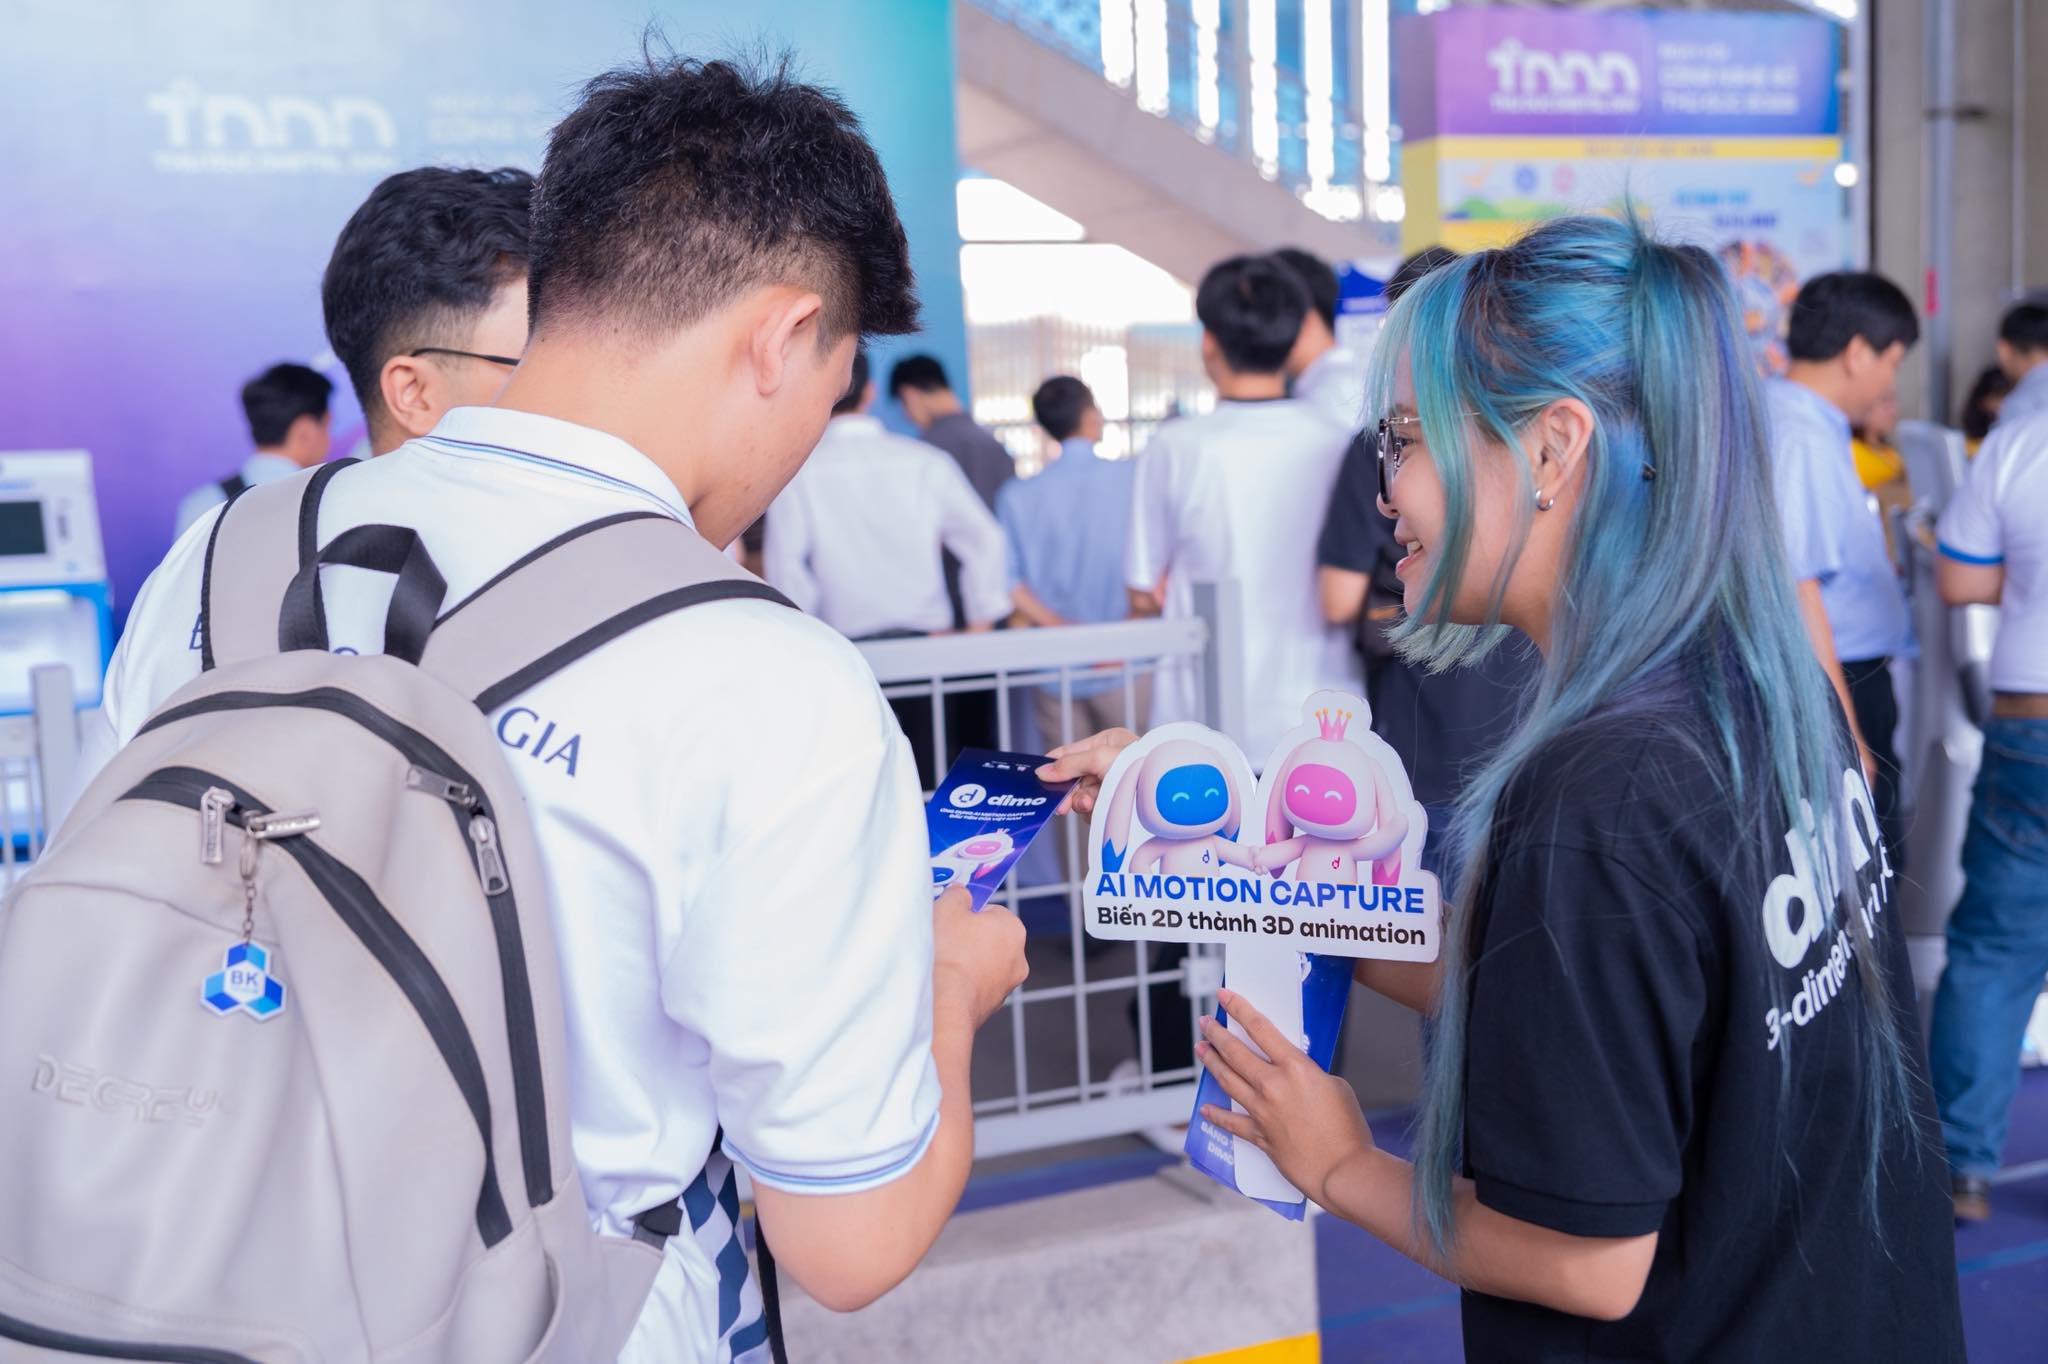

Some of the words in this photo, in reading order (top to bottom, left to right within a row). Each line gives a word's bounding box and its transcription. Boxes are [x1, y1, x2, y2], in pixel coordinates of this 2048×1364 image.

[497, 706, 581, 777] GIA
[987, 794, 1047, 807] dimo
[1096, 873, 1126, 897] AI
[1134, 874, 1262, 904] MOTION
[1269, 880, 1424, 914] CAPTURE
[1097, 904, 1146, 926] Biến
[1151, 909, 1183, 928] 2D
[1187, 911, 1257, 933] thành
[1262, 915, 1295, 936] 3D
[1300, 918, 1425, 945] animation
[231, 970, 258, 985] BK
